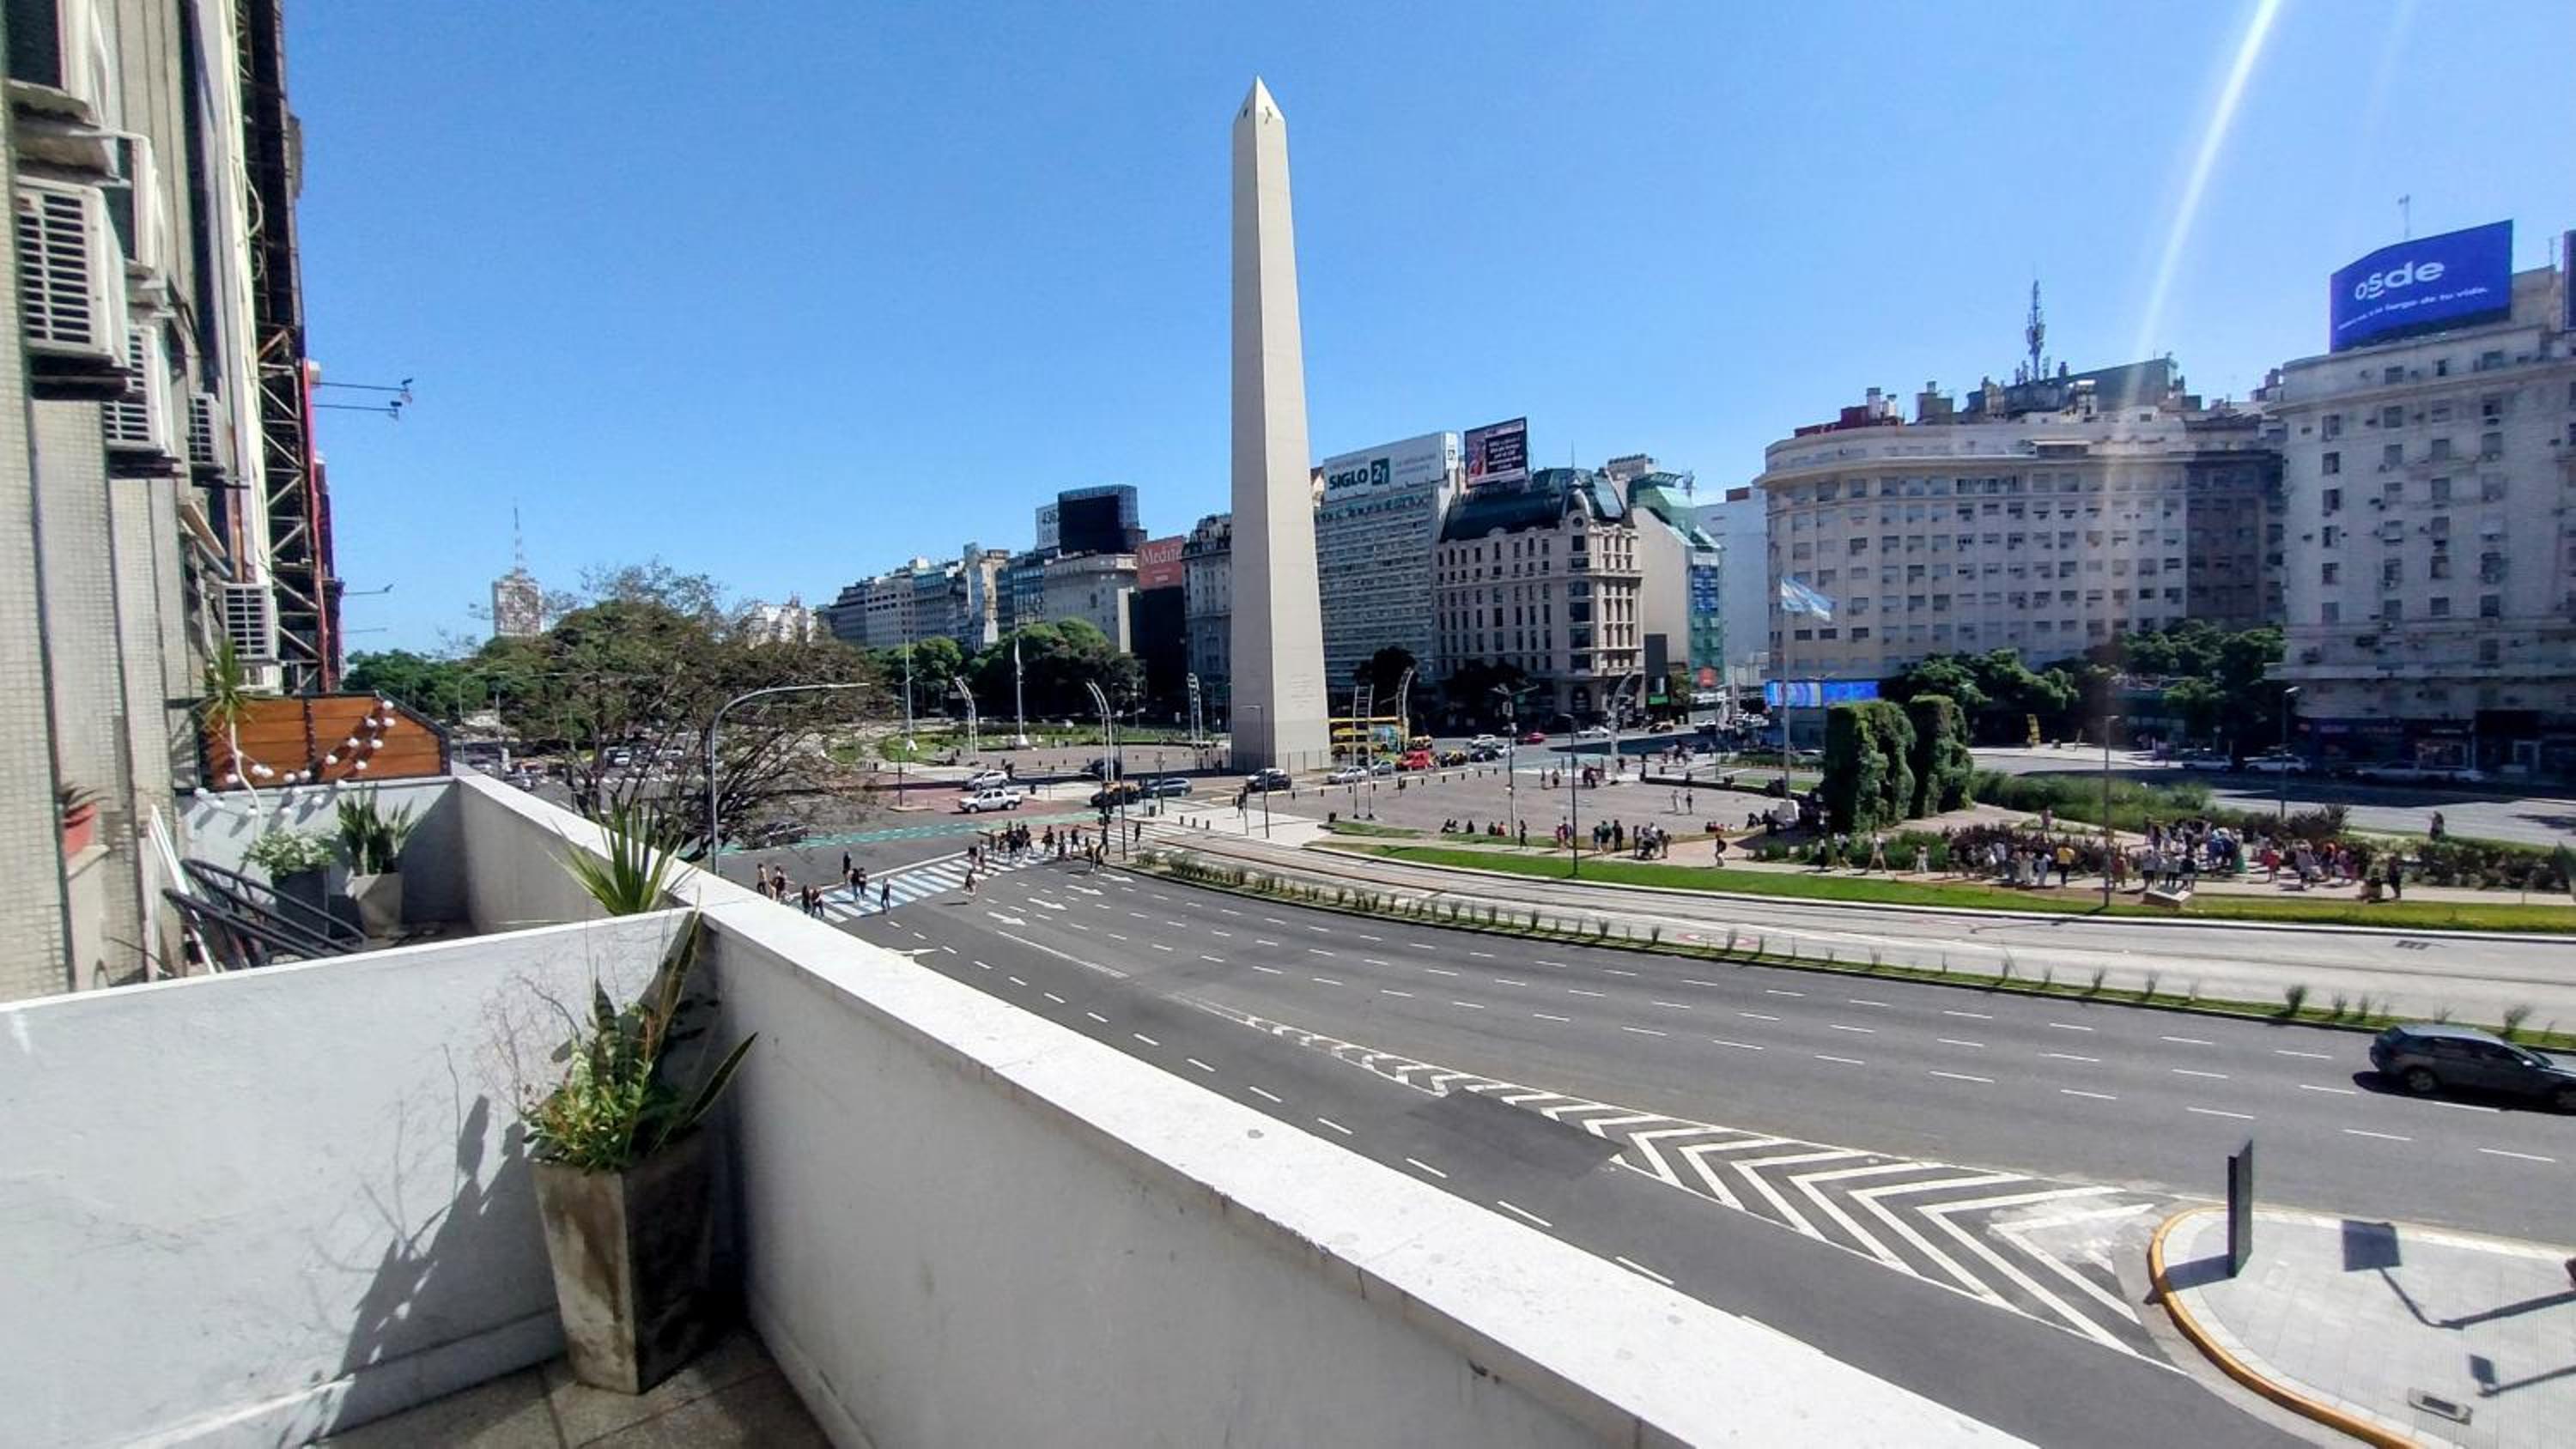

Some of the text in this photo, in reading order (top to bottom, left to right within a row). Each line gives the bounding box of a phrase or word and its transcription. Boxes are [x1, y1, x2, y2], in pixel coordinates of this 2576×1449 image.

[2354, 261, 2445, 300] osde
[1328, 469, 1369, 490] SIGLO
[1372, 460, 1388, 484] 21
